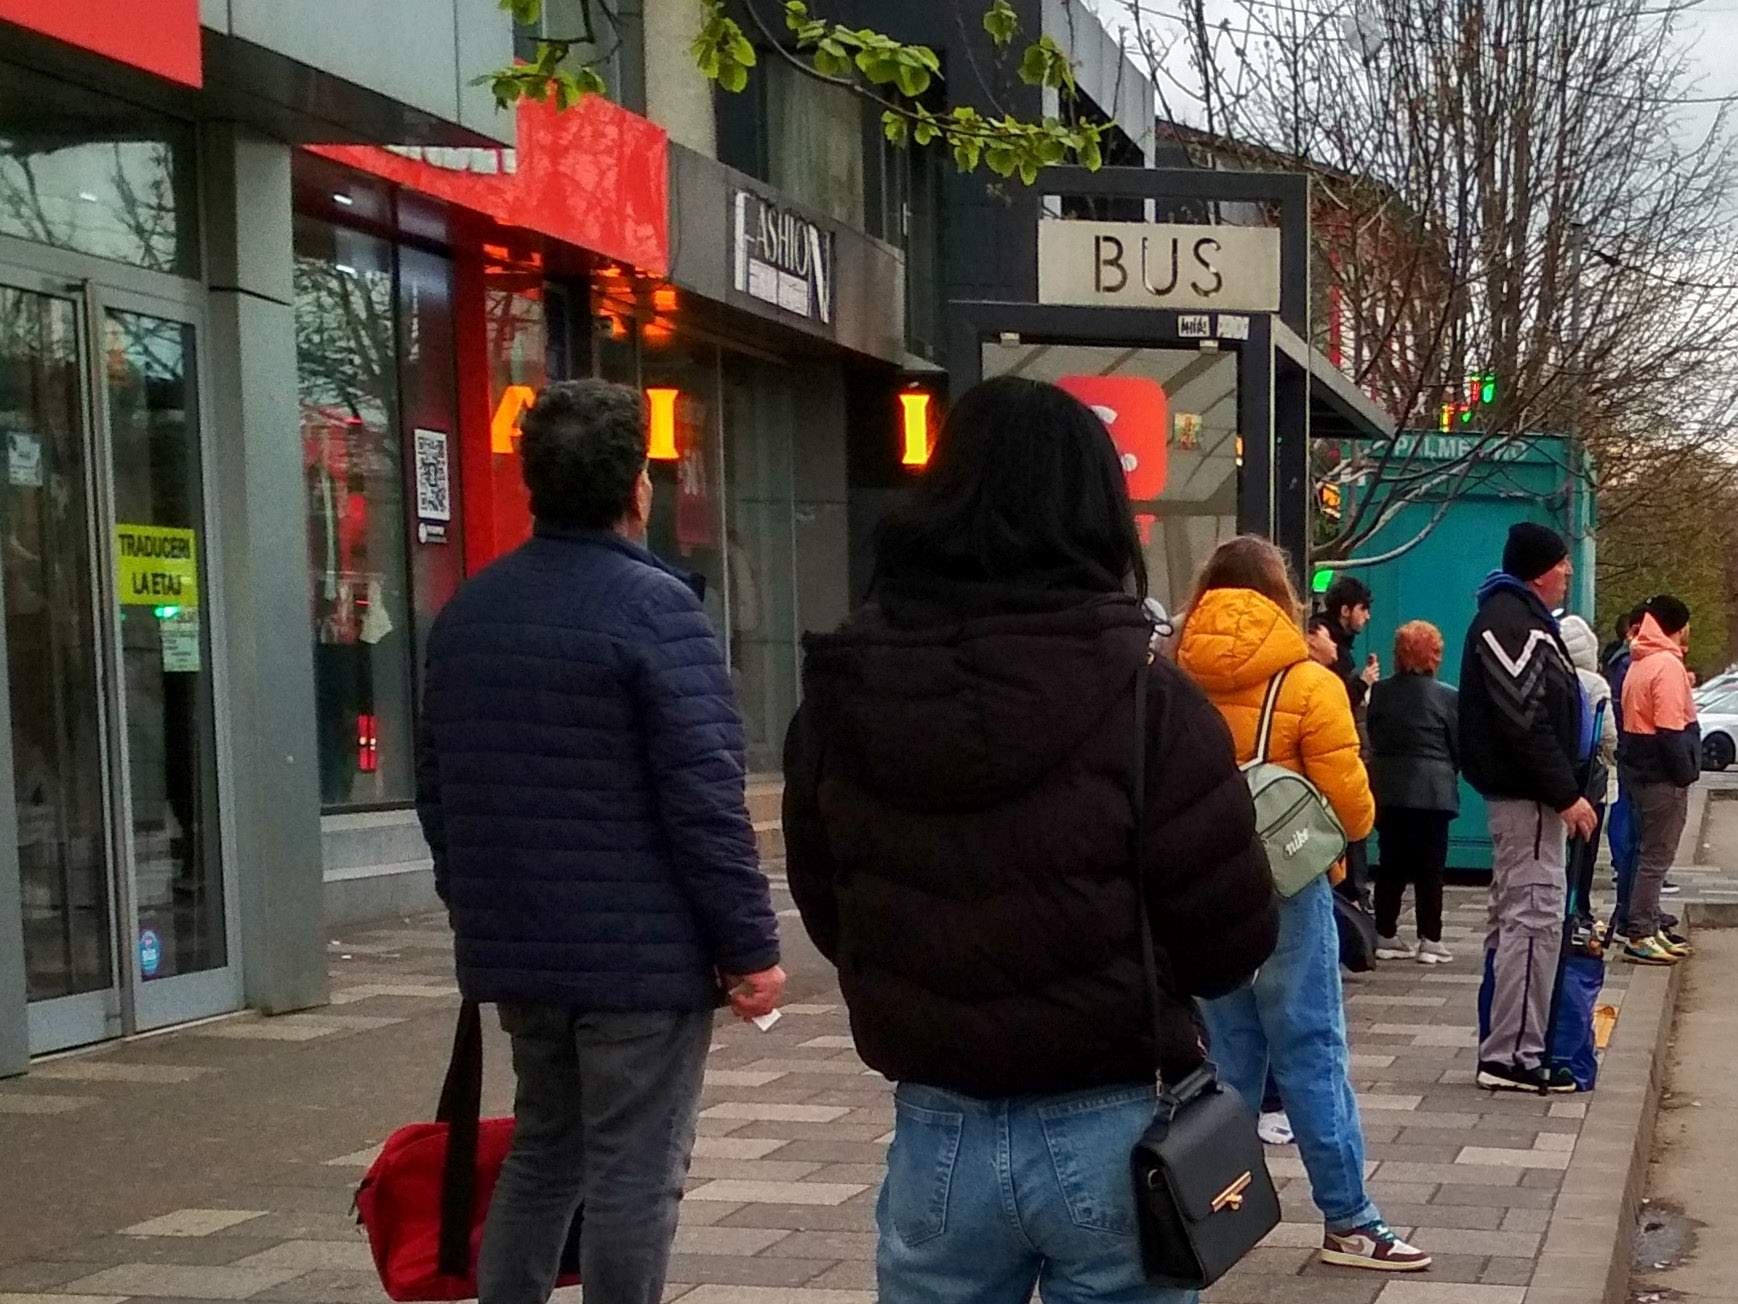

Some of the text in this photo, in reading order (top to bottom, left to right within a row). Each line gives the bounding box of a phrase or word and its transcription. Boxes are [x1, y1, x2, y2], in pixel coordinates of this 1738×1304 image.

[734, 189, 831, 325] FASHION
[1094, 235, 1223, 298] BUS
[118, 533, 190, 559] TRADUCERI
[132, 572, 182, 597] LA ETAJ
